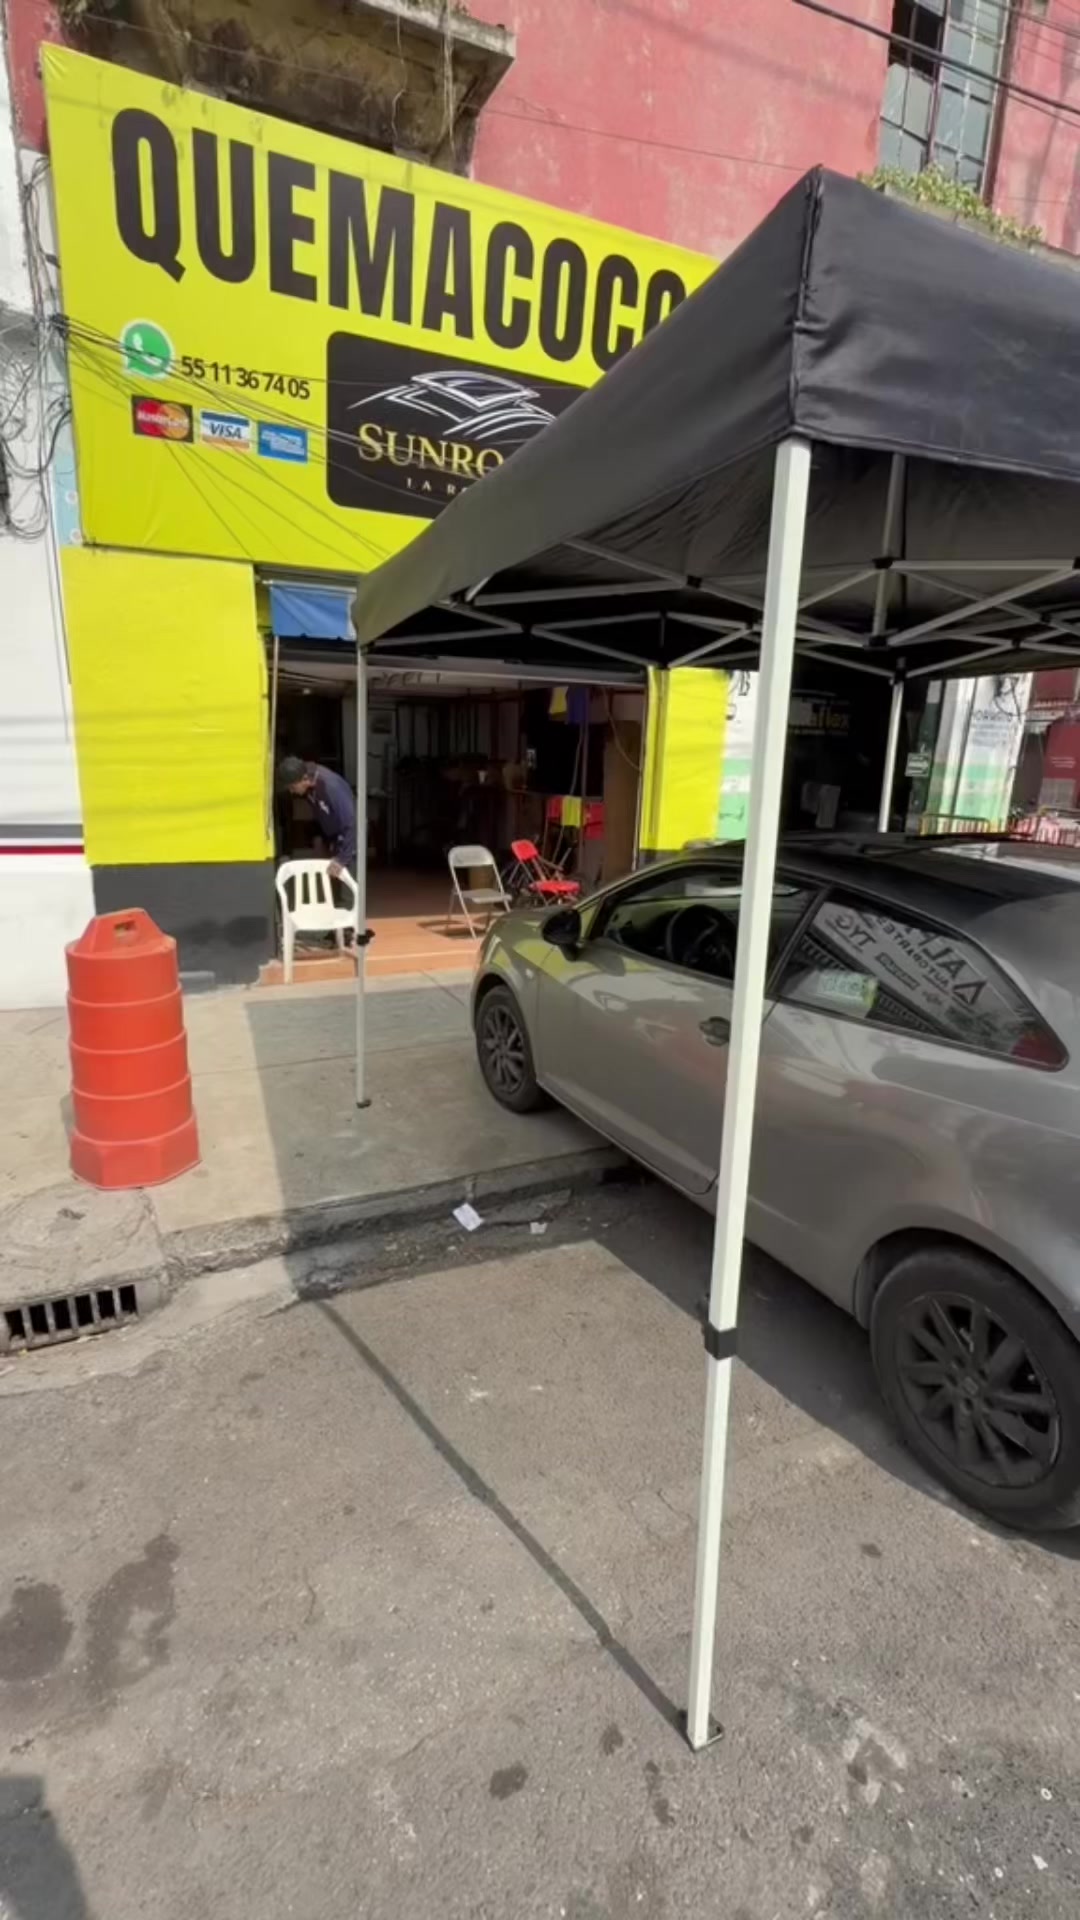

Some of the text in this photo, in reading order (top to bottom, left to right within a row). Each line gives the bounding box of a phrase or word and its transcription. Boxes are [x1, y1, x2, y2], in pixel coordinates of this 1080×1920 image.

[181, 356, 310, 400] 55 11 36 74 05
[210, 422, 243, 439] VISA
